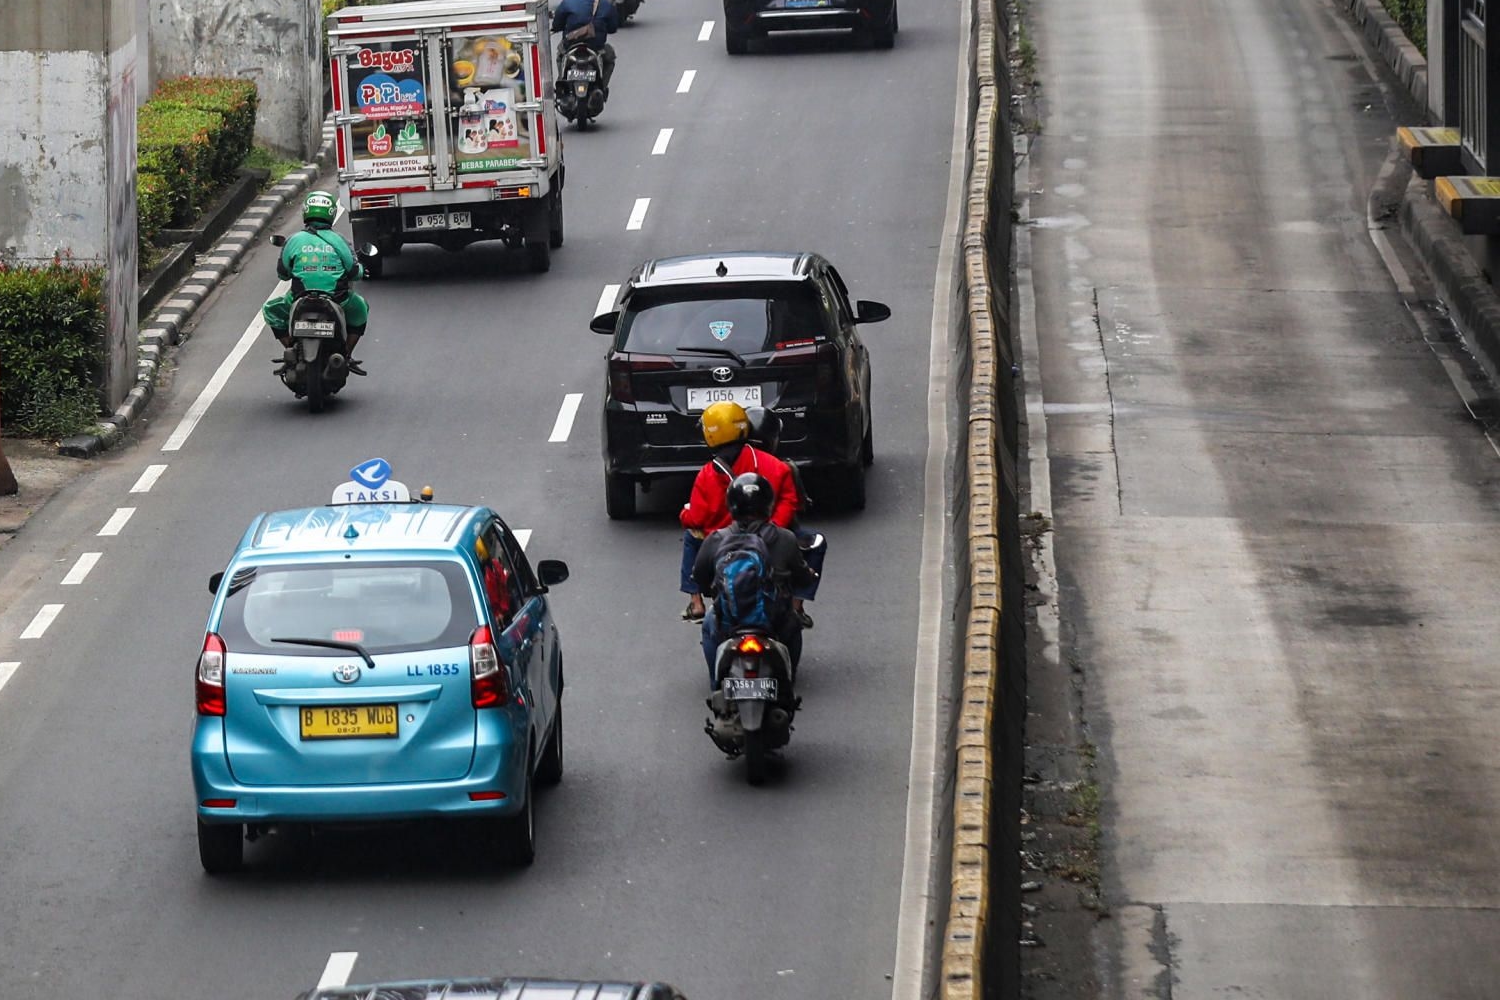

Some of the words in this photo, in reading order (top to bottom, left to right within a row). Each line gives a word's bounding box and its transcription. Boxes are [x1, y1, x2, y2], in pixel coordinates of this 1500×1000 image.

[358, 49, 414, 72] Bagus
[361, 83, 401, 105] PiPi
[372, 144, 388, 152] Free
[372, 160, 399, 168] PENCUCI
[382, 166, 418, 174] PERALATAN
[461, 160, 485, 169] BEBAS
[417, 216, 424, 227] B
[427, 214, 449, 225] 952
[690, 391, 697, 403] F
[706, 390, 734, 402] 1056
[345, 489, 398, 502] TAKSI
[406, 665, 424, 677] LL
[429, 663, 460, 676] 1835
[304, 711, 314, 727] B
[324, 708, 358, 726] 1835
